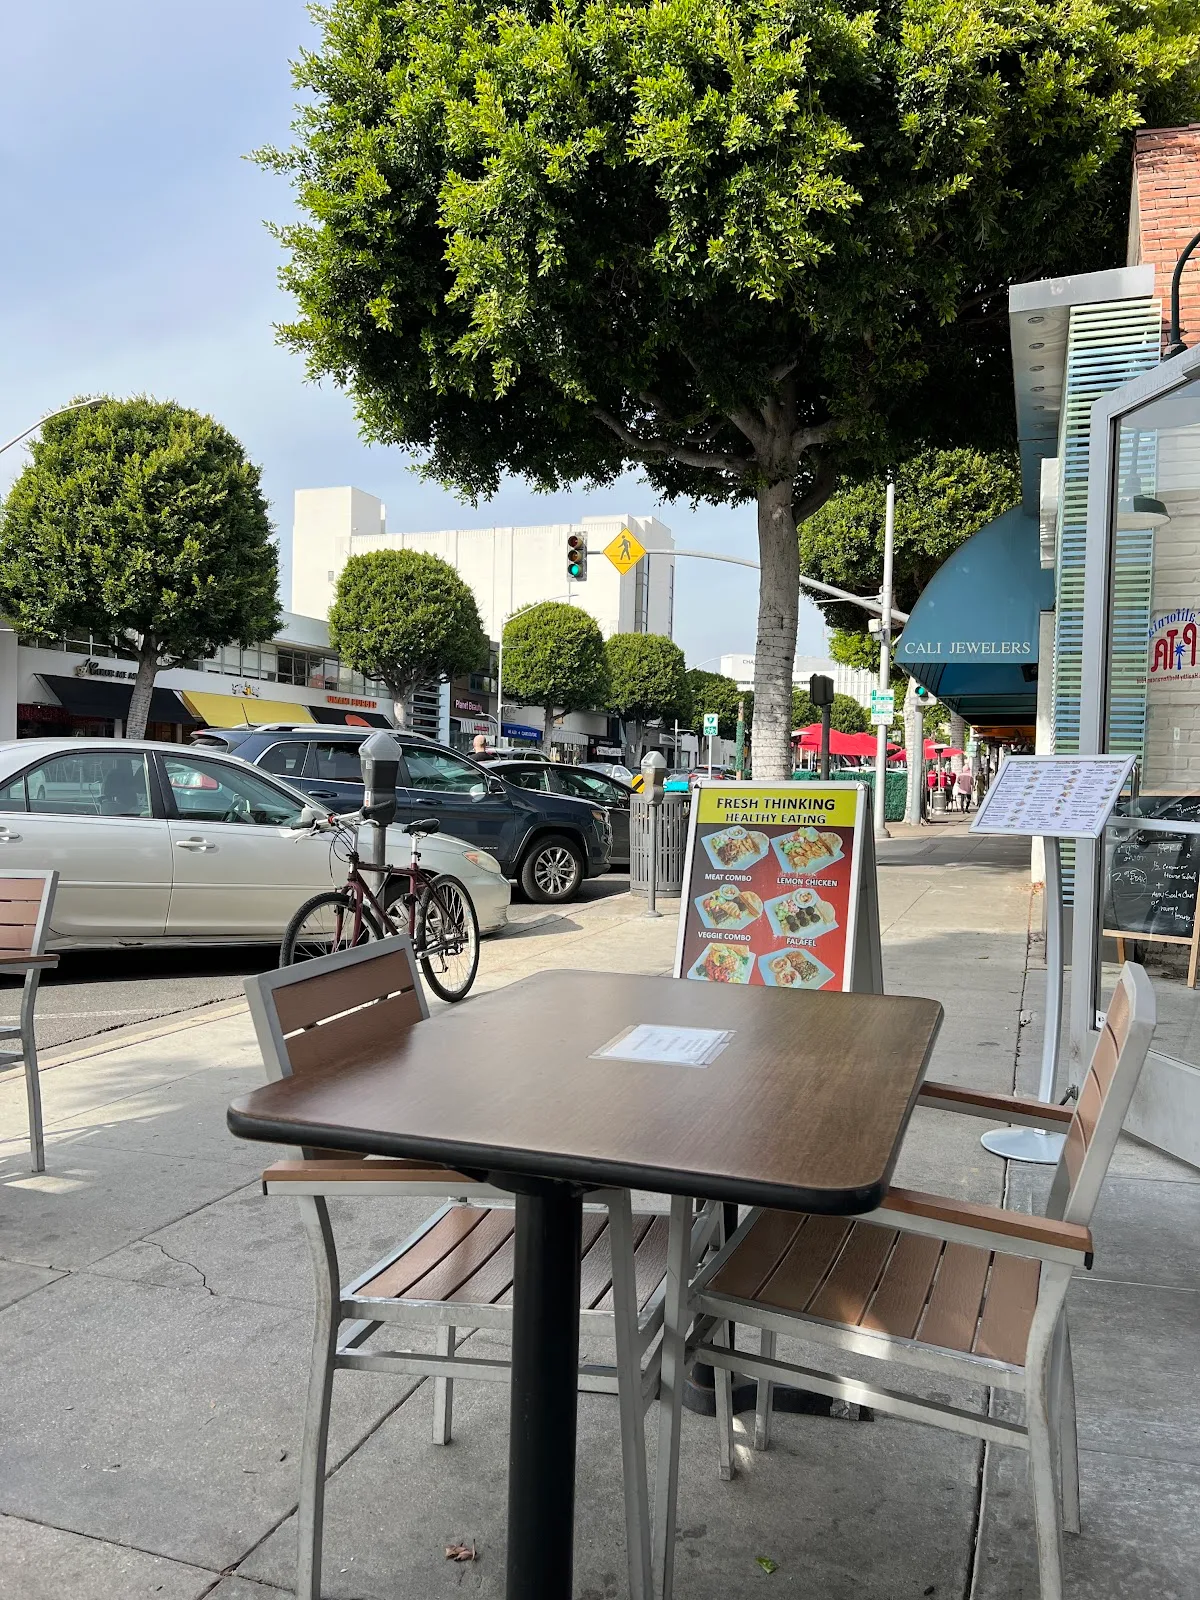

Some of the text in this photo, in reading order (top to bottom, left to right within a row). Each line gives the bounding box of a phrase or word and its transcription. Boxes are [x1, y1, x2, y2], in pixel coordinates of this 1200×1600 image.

[904, 642, 1031, 654] CALI JEWELERS
[716, 797, 835, 811] FRESH THINKING
[725, 813, 826, 824] HEALTHY EATING
[704, 873, 752, 882] MEAT COMBO
[776, 877, 838, 887] LEMON CHICKEN
[698, 930, 751, 941] VEGGIE COMBO
[786, 937, 817, 947] FALAFEL
